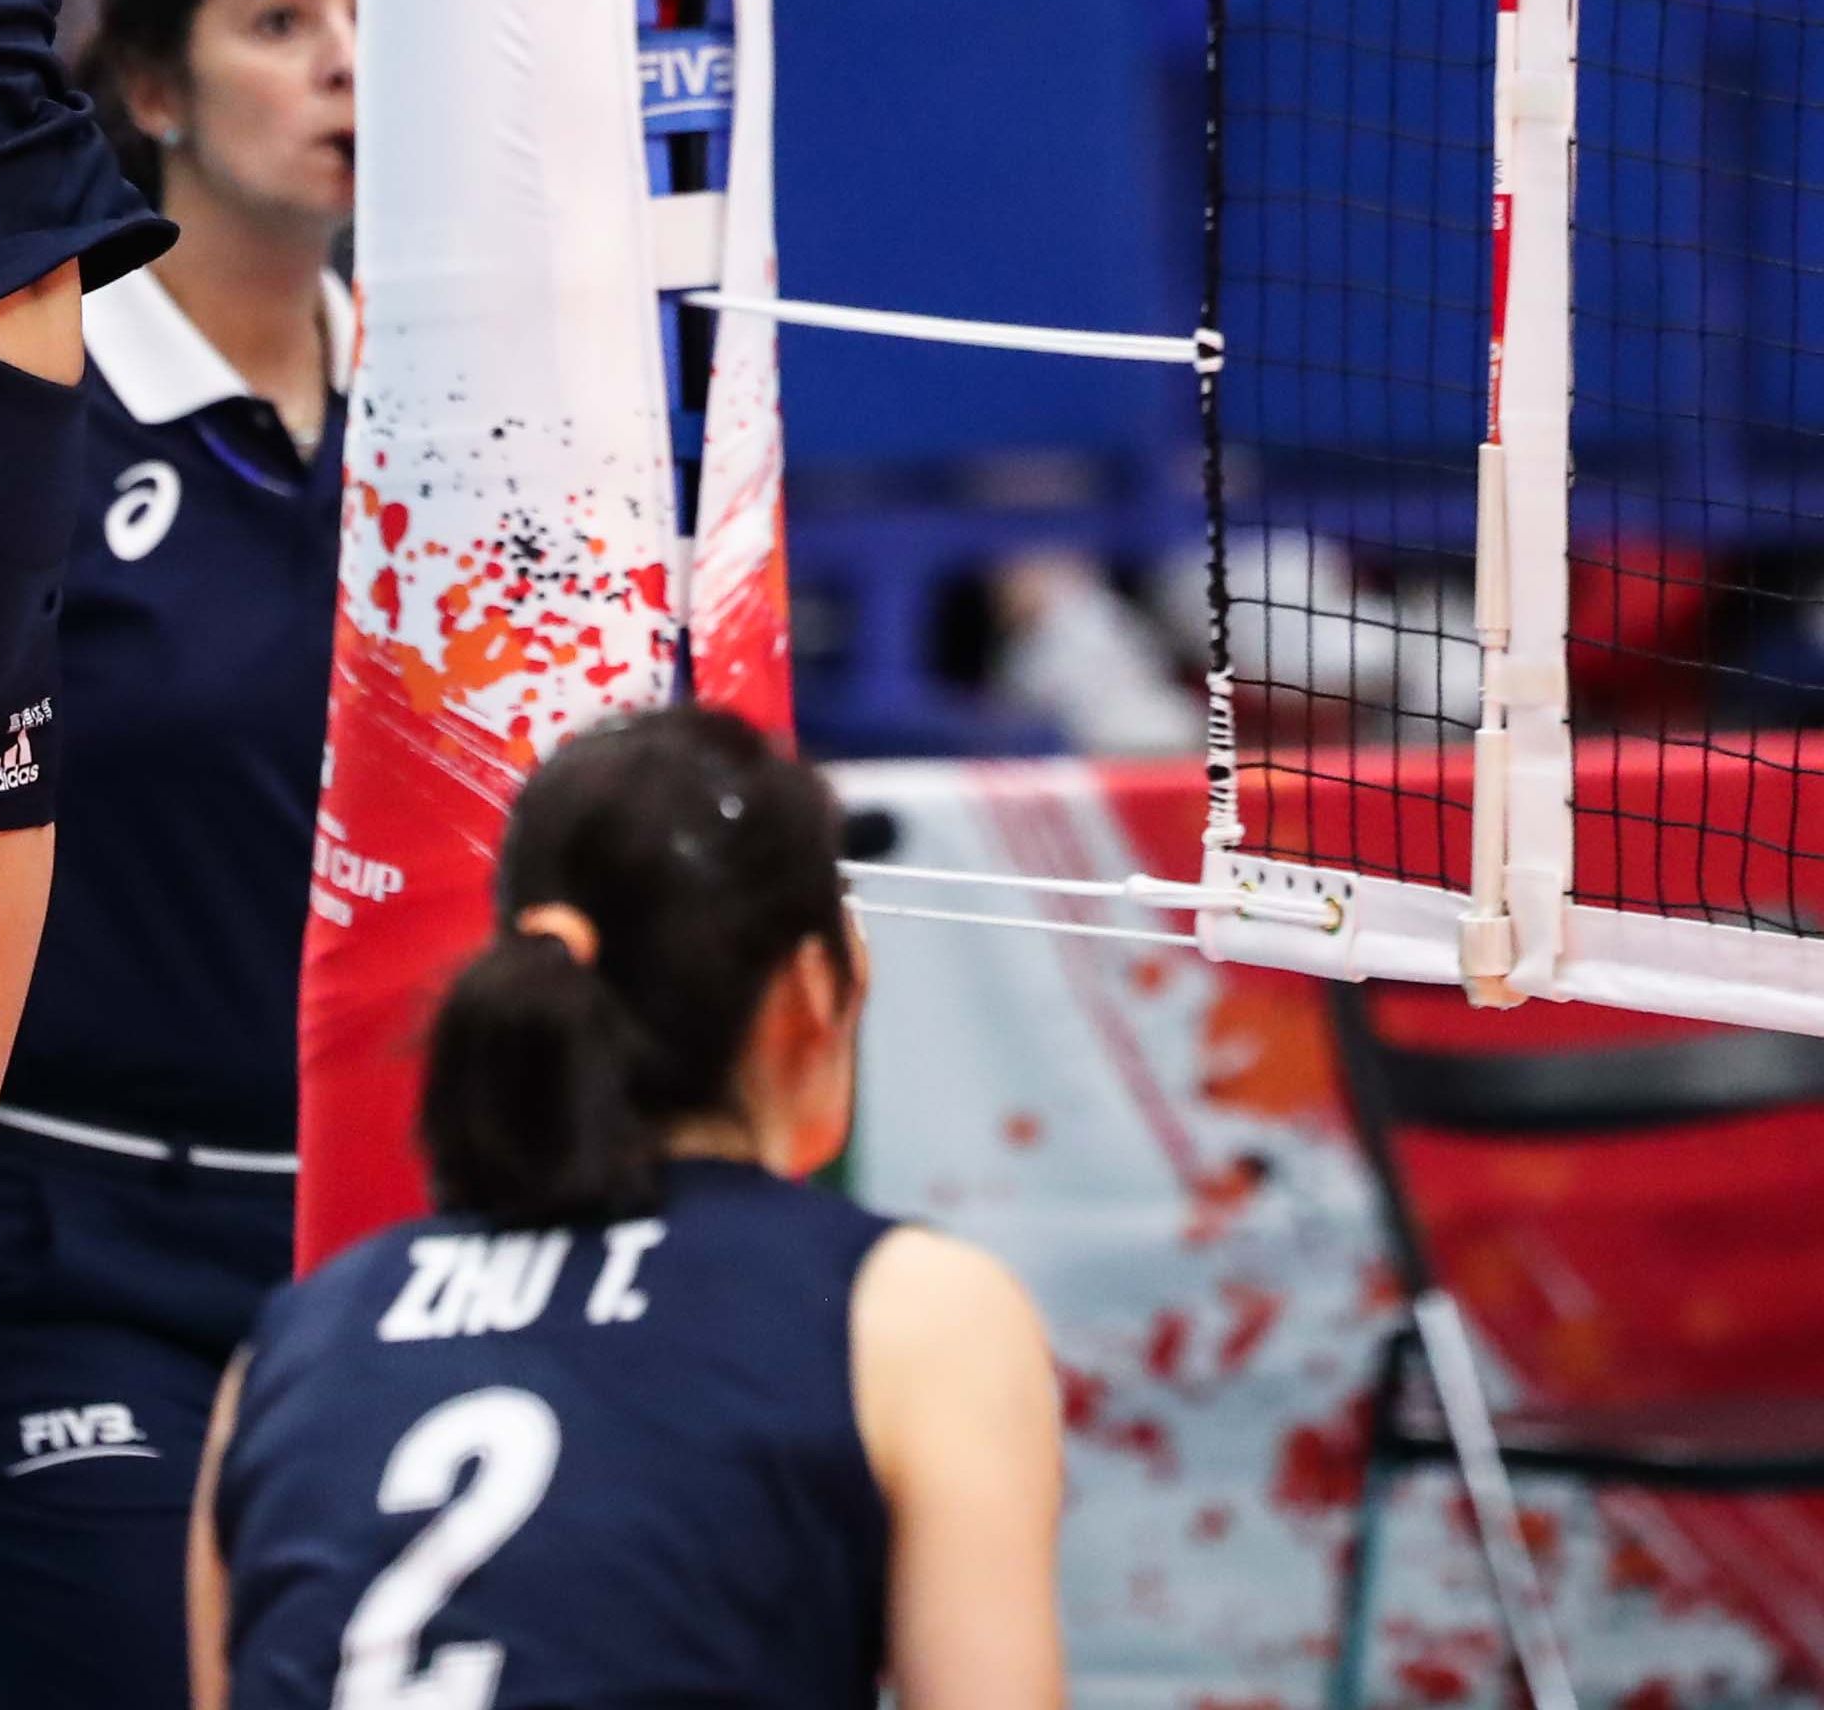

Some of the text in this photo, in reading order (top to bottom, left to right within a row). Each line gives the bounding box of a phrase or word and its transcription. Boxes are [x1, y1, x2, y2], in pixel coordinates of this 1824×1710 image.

[378, 1216, 669, 1343] ZHU T.
[19, 1402, 138, 1456] FIVB
[329, 1385, 564, 1710] 2
